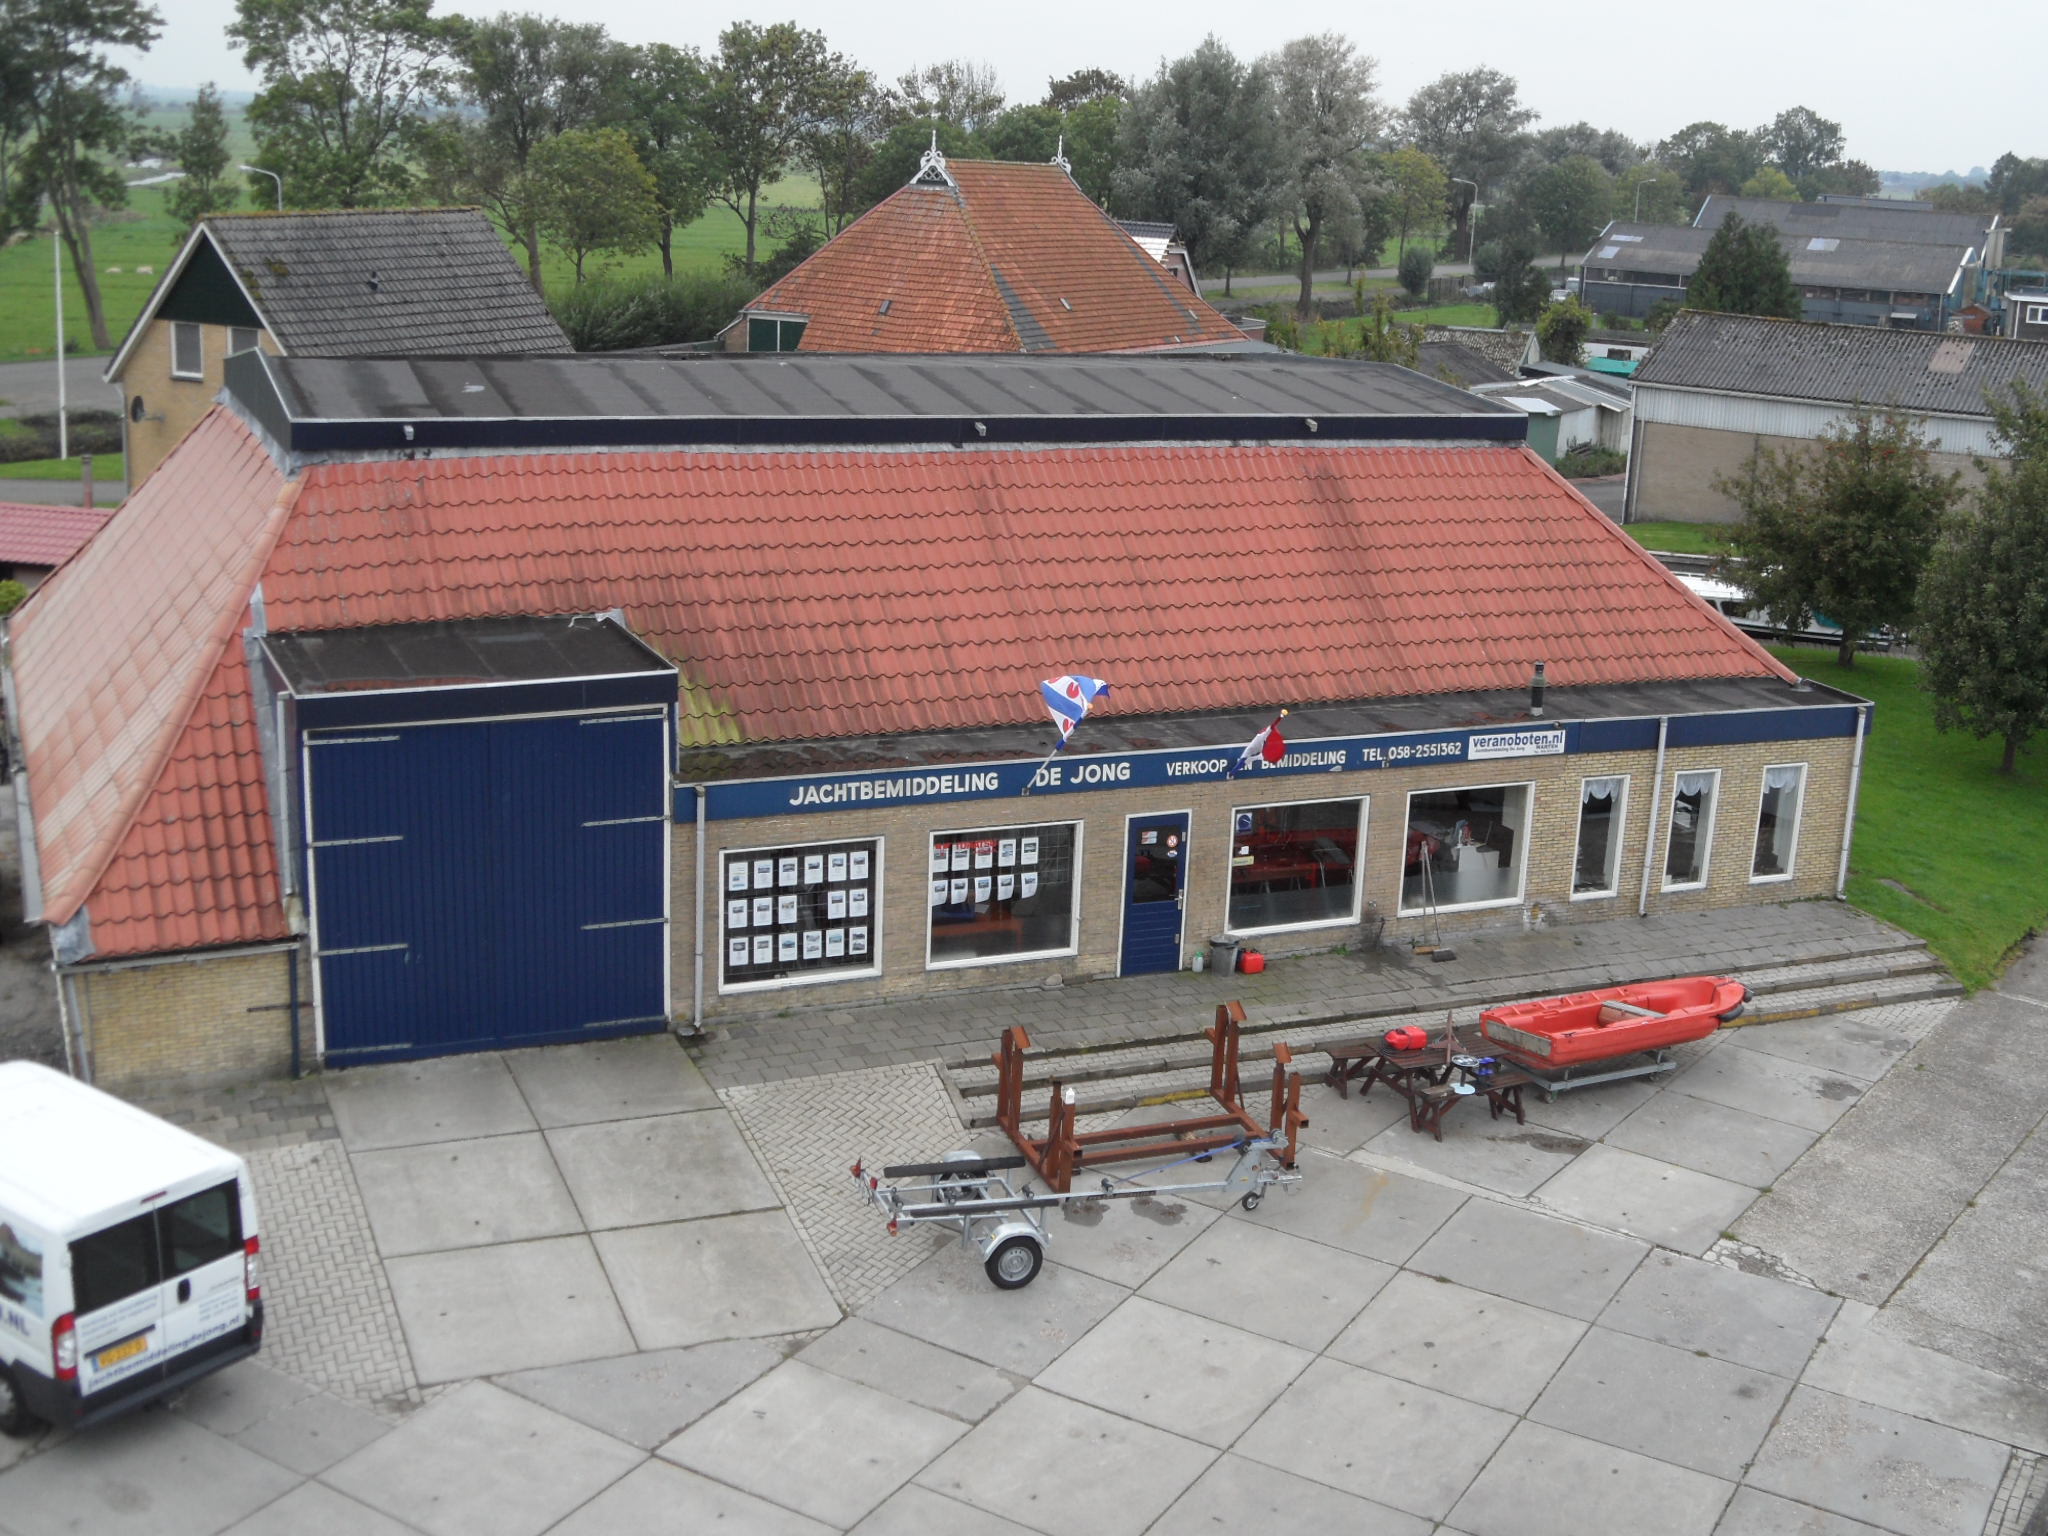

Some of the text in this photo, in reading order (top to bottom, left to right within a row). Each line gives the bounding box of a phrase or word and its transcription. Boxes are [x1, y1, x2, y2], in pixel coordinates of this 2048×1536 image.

[1473, 731, 1563, 748] veranoboten.nl
[1166, 759, 1228, 777] VERKOOP
[789, 762, 1131, 806] JACHTBEMIDDELING DE JONG
